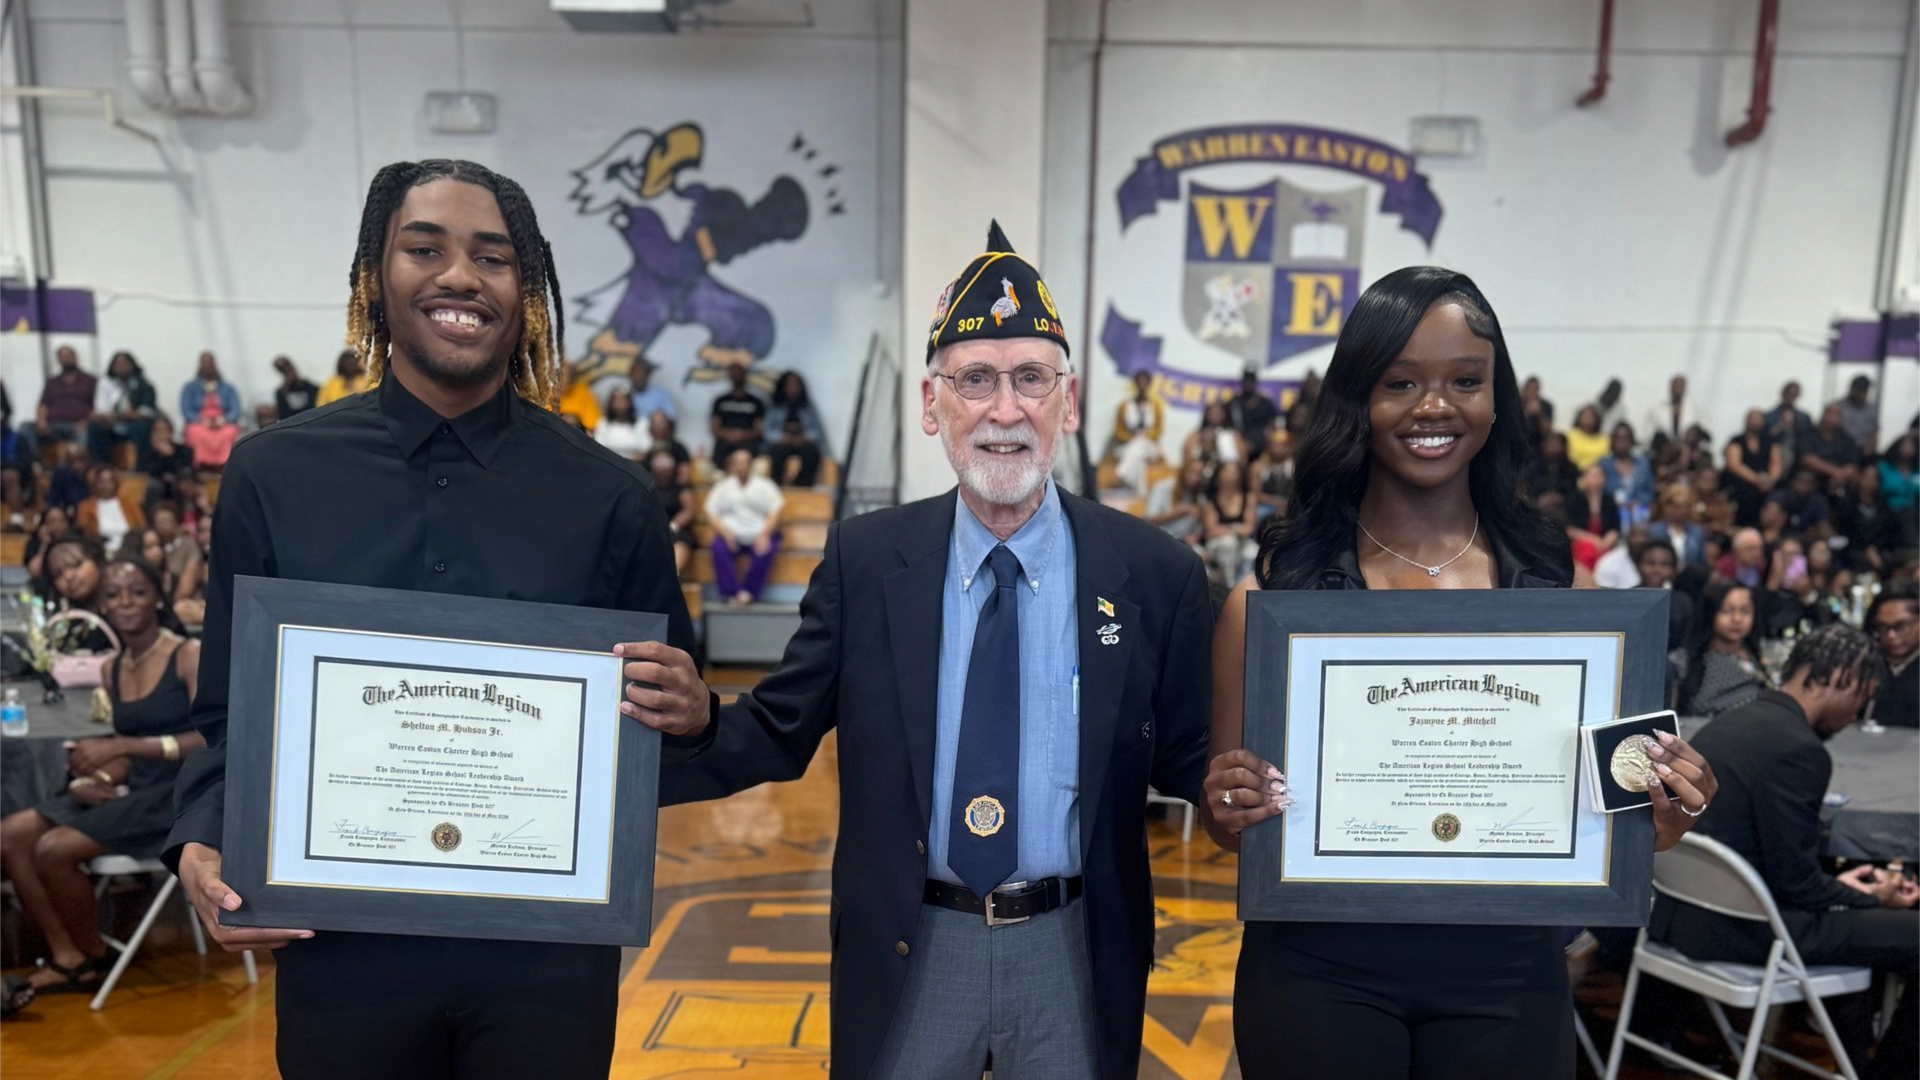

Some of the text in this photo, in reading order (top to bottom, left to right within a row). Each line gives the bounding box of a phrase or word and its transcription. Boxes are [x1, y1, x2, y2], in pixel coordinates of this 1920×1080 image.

[1157, 133, 1408, 182] WARREN EASTON
[1192, 196, 1272, 258] W
[1283, 273, 1343, 335] E
[957, 317, 985, 333] 307
[362, 680, 542, 720] The American Legion
[1366, 673, 1541, 706] The American Legion
[400, 720, 503, 736] Shelton M. Hudson Jr.
[1447, 717, 1460, 725] M.
[1462, 717, 1497, 726] Mitchell
[388, 742, 513, 758] Warren Easton Charter High School
[1392, 739, 1512, 747] Warren Easton Charter High School
